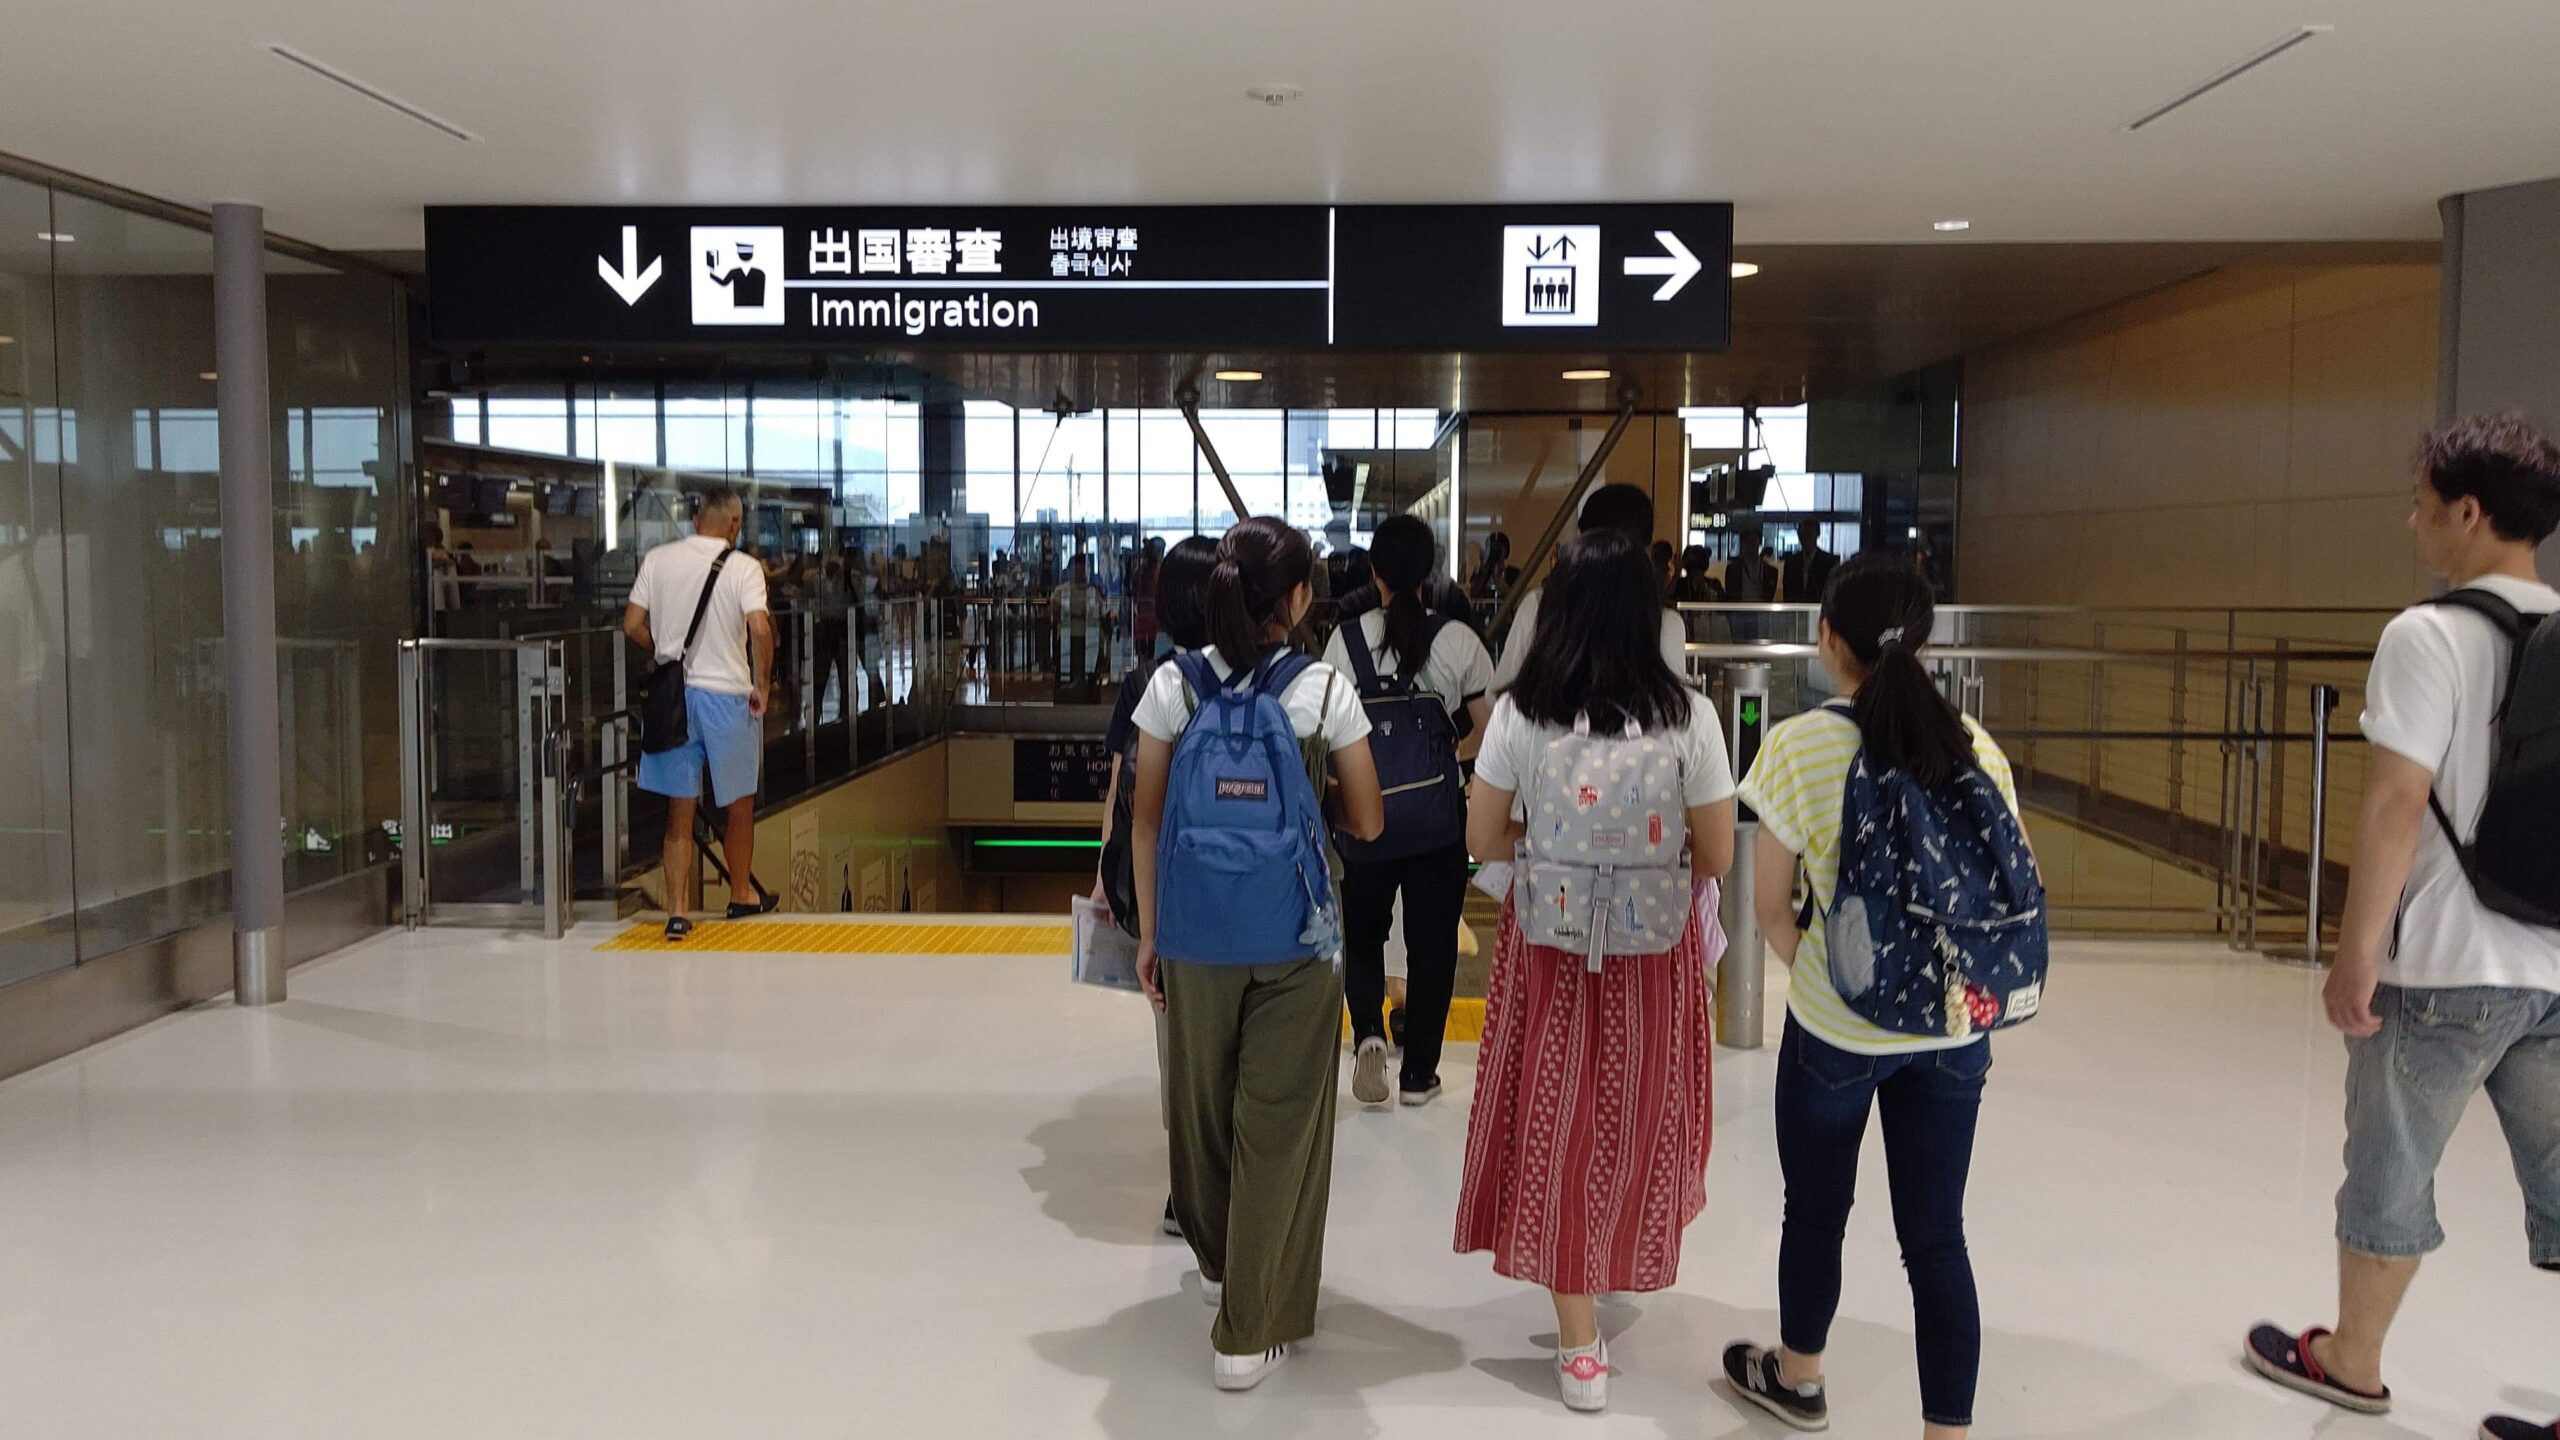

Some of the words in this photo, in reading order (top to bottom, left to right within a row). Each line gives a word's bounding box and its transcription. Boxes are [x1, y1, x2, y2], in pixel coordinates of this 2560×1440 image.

[808, 227, 1003, 275] 出国審査
[1050, 226, 1138, 251] 出境审查
[1050, 252, 1132, 277] 출국심사
[810, 291, 1039, 336] Immigration
[1048, 743, 1113, 758] お気をつ
[1050, 759, 1069, 772] WE
[1086, 759, 1111, 772] HOP
